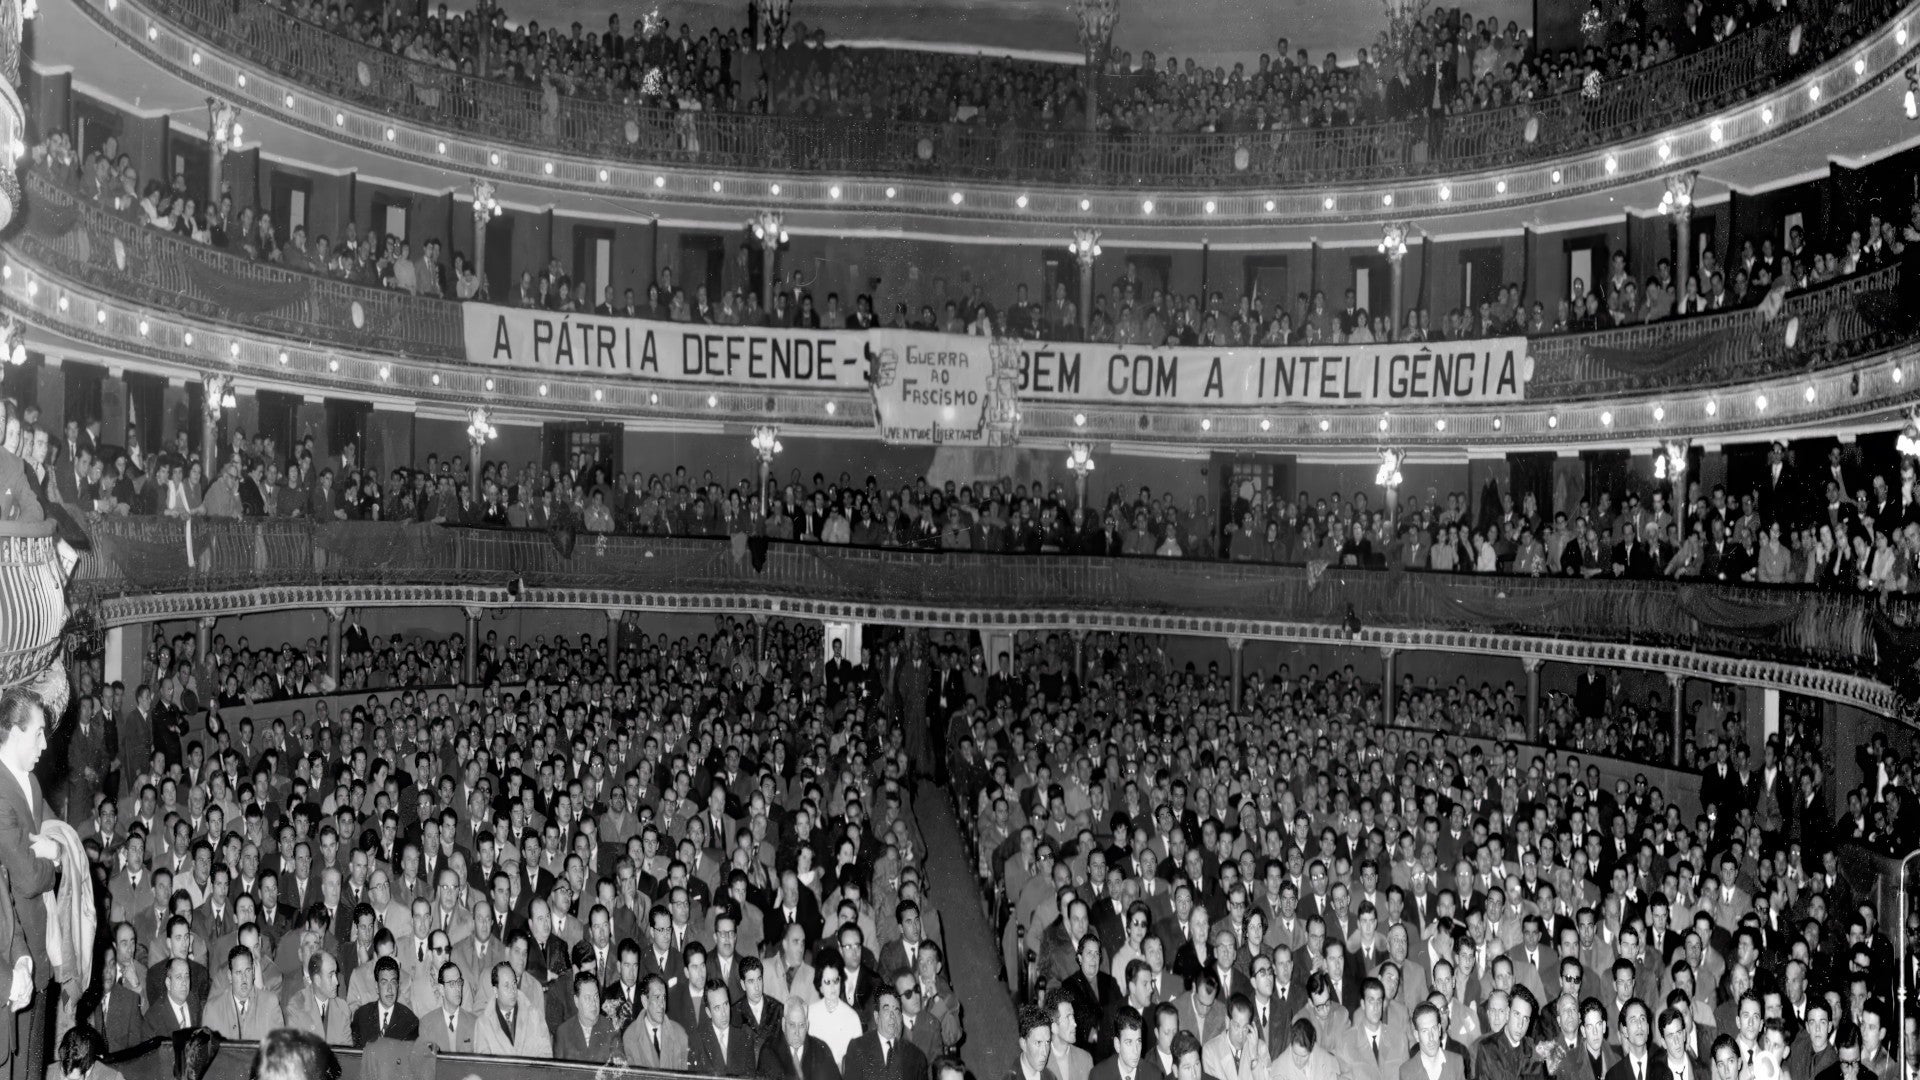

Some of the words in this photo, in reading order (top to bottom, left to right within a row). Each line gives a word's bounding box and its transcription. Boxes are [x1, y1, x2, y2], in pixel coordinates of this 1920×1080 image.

[493, 314, 512, 360] A
[533, 314, 659, 373] PÁTRIA
[1018, 344, 1081, 394] BÉM
[1107, 353, 1178, 398] COM
[1203, 356, 1224, 398] A
[1257, 345, 1517, 399] INTELIGÊNCIA
[906, 345, 969, 368] GUERRA
[930, 369, 950, 385] AO
